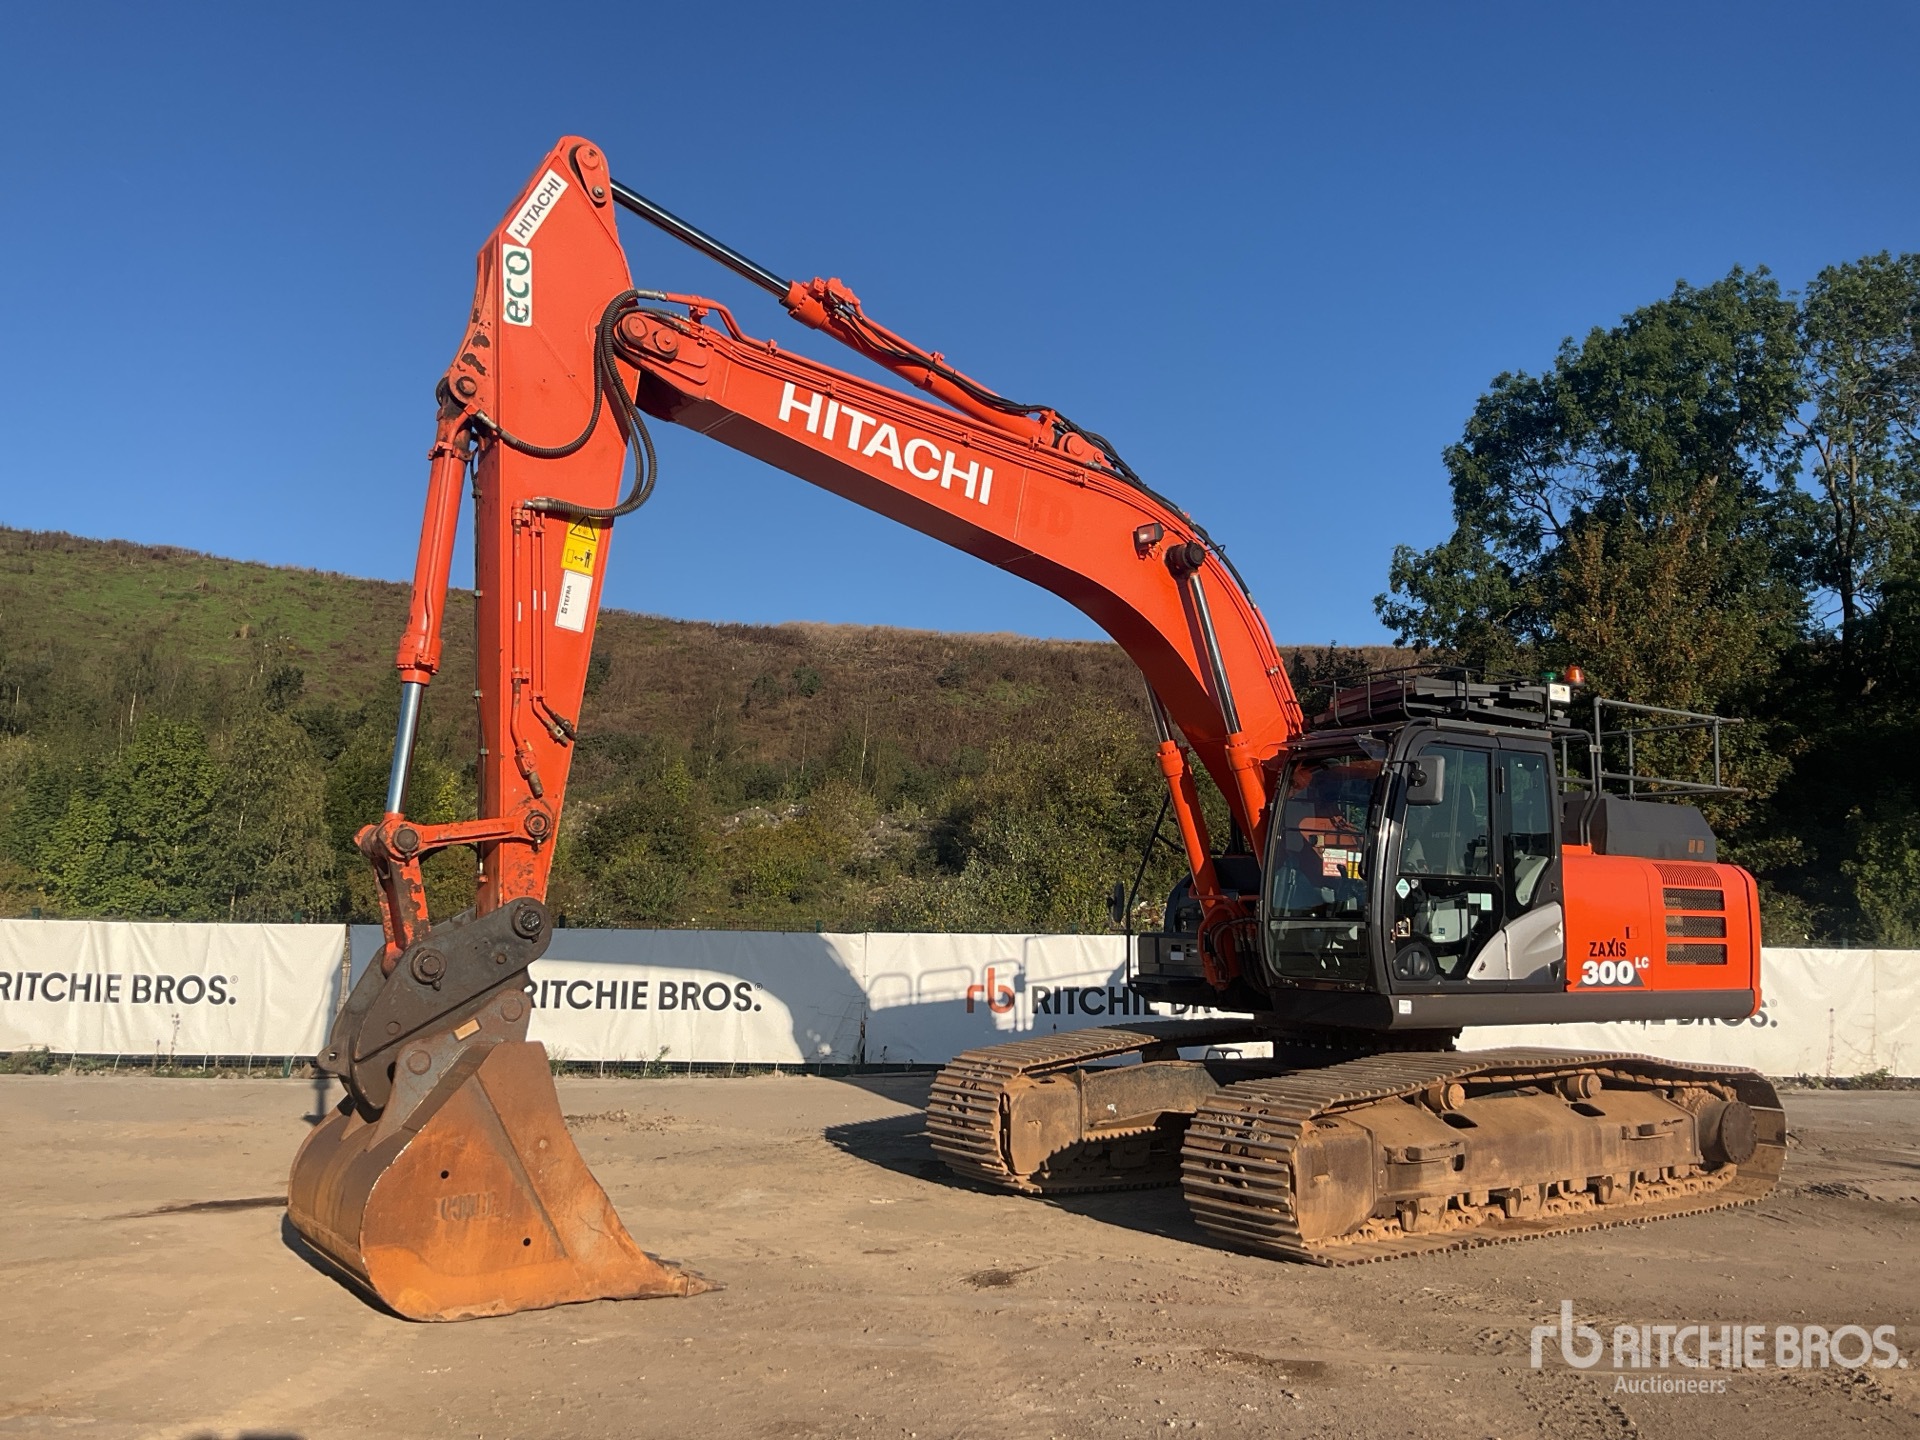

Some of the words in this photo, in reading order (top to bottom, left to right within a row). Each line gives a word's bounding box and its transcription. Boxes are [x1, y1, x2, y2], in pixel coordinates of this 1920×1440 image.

[514, 177, 562, 239] HITACHI
[778, 381, 993, 506] HITACHI
[1589, 938, 1627, 957] ZAXIS
[966, 968, 1015, 1013] rb
[1581, 960, 1634, 985] 300
[1635, 957, 1650, 969] LC
